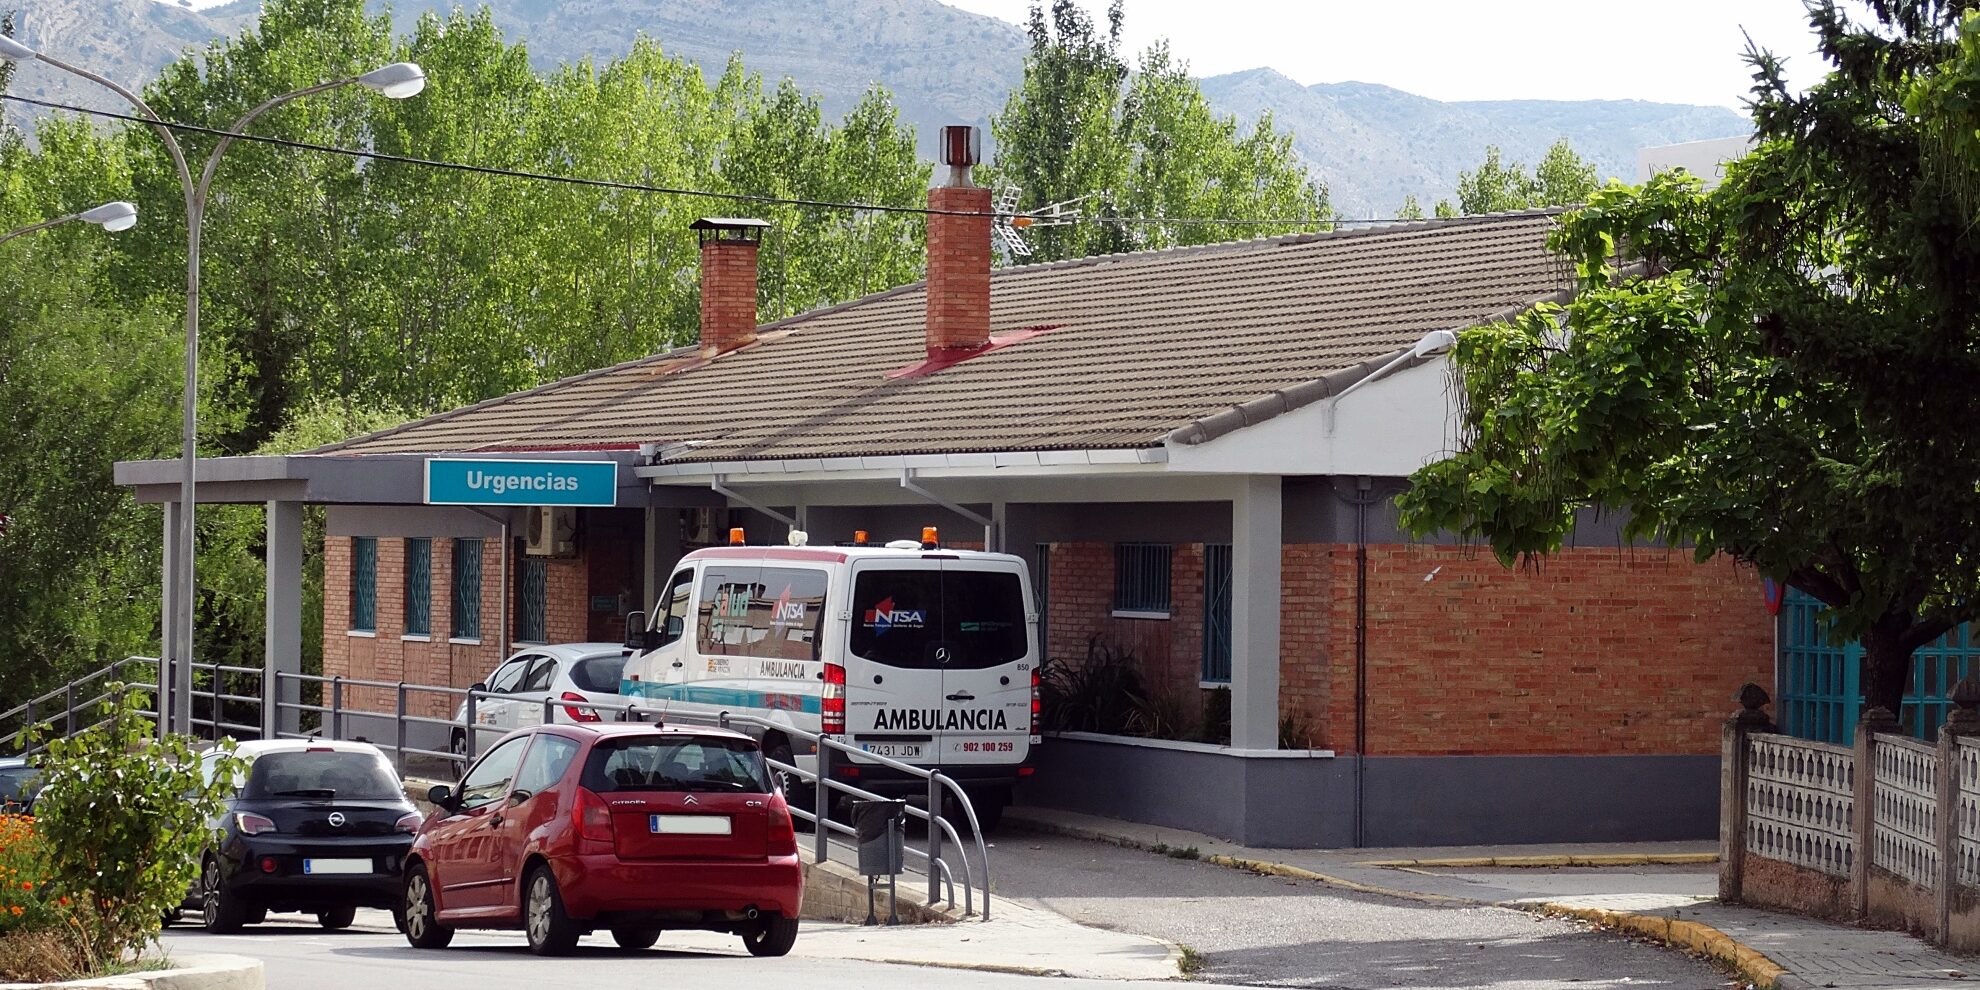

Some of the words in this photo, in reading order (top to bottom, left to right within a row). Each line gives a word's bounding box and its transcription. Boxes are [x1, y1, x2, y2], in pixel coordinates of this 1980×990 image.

[467, 470, 578, 494] Urgencias
[714, 583, 753, 617] salud
[776, 600, 804, 620] NTSA
[875, 608, 923, 624] NTSA
[760, 660, 805, 679] AMBULANCIA
[873, 708, 1008, 731] AMBULANCIA
[869, 745, 896, 757] 7431
[900, 745, 920, 757] JDW
[963, 742, 979, 752] 902
[982, 742, 996, 752] 100
[998, 742, 1014, 752] 259
